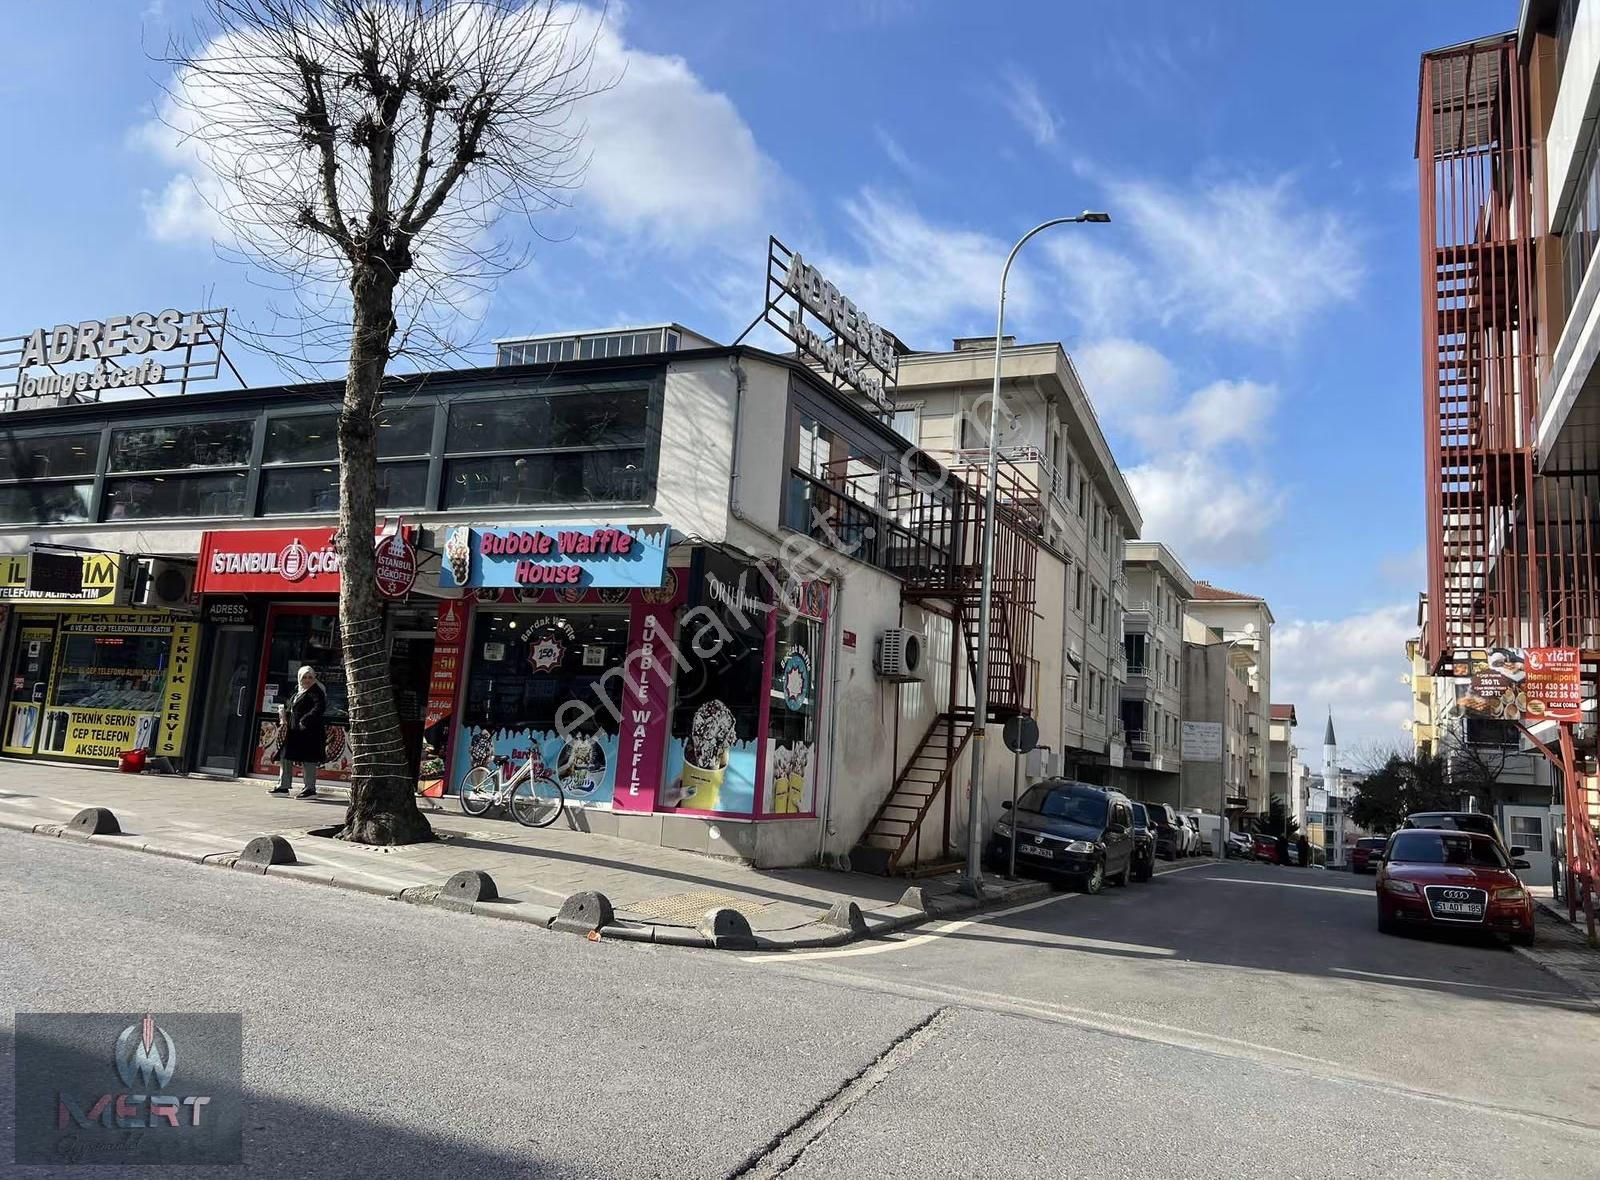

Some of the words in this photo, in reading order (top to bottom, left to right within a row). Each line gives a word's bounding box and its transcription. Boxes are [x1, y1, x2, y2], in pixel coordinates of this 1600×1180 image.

[19, 308, 207, 368] ADRESS+
[480, 530, 552, 555] Bubble
[557, 529, 633, 555] Waffle
[211, 548, 280, 574] İSTANBUL
[378, 553, 412, 571] İSTANBUL
[515, 560, 582, 584] House
[209, 604, 248, 615] ADRESS+
[521, 617, 550, 642] Bardak
[553, 616, 576, 641] Waffle
[638, 614, 656, 699] BUBBLE
[1546, 651, 1576, 662] YİĞİT
[72, 711, 103, 725] TEKNİK
[105, 713, 136, 727] SERVİS
[72, 728, 89, 739] CEP
[91, 729, 130, 742] TELEFON
[629, 709, 651, 797] WAFFLE
